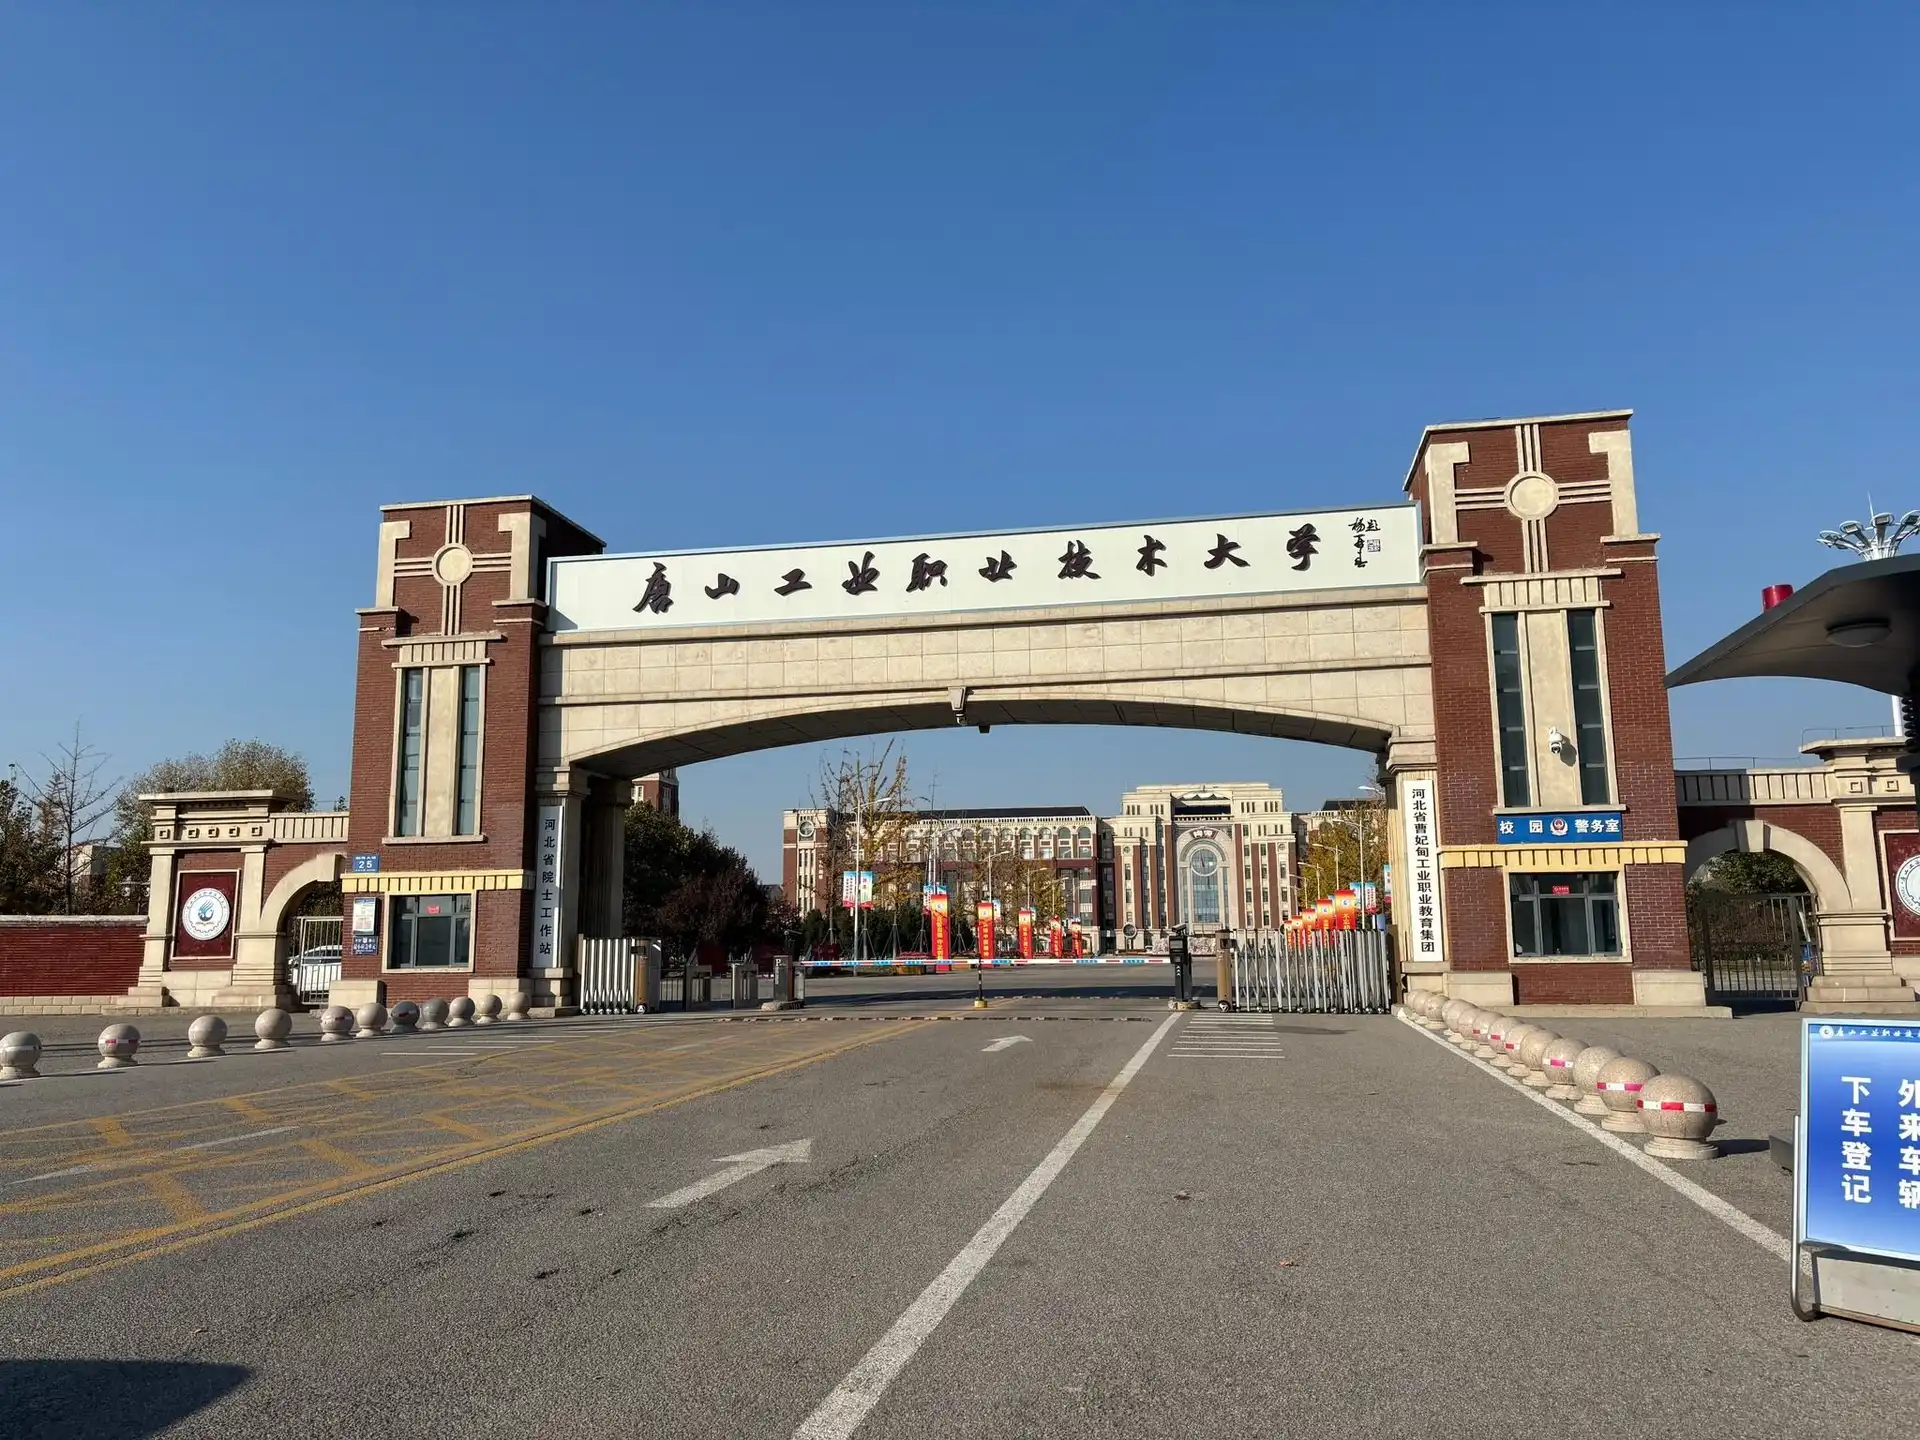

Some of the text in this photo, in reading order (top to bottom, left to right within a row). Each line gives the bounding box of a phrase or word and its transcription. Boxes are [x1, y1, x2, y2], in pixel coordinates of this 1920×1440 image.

[632, 523, 1321, 614] 唐山工业职业技术大学
[358, 860, 373, 869] 25
[539, 818, 556, 956] 河北省院士工作站
[1411, 788, 1435, 953] 河北省曹妃甸工业职业教育集团
[1499, 818, 1620, 835] 校园 警务室
[1841, 1076, 1872, 1204] 下车登记
[1898, 1078, 1920, 1209] 外来车辆
